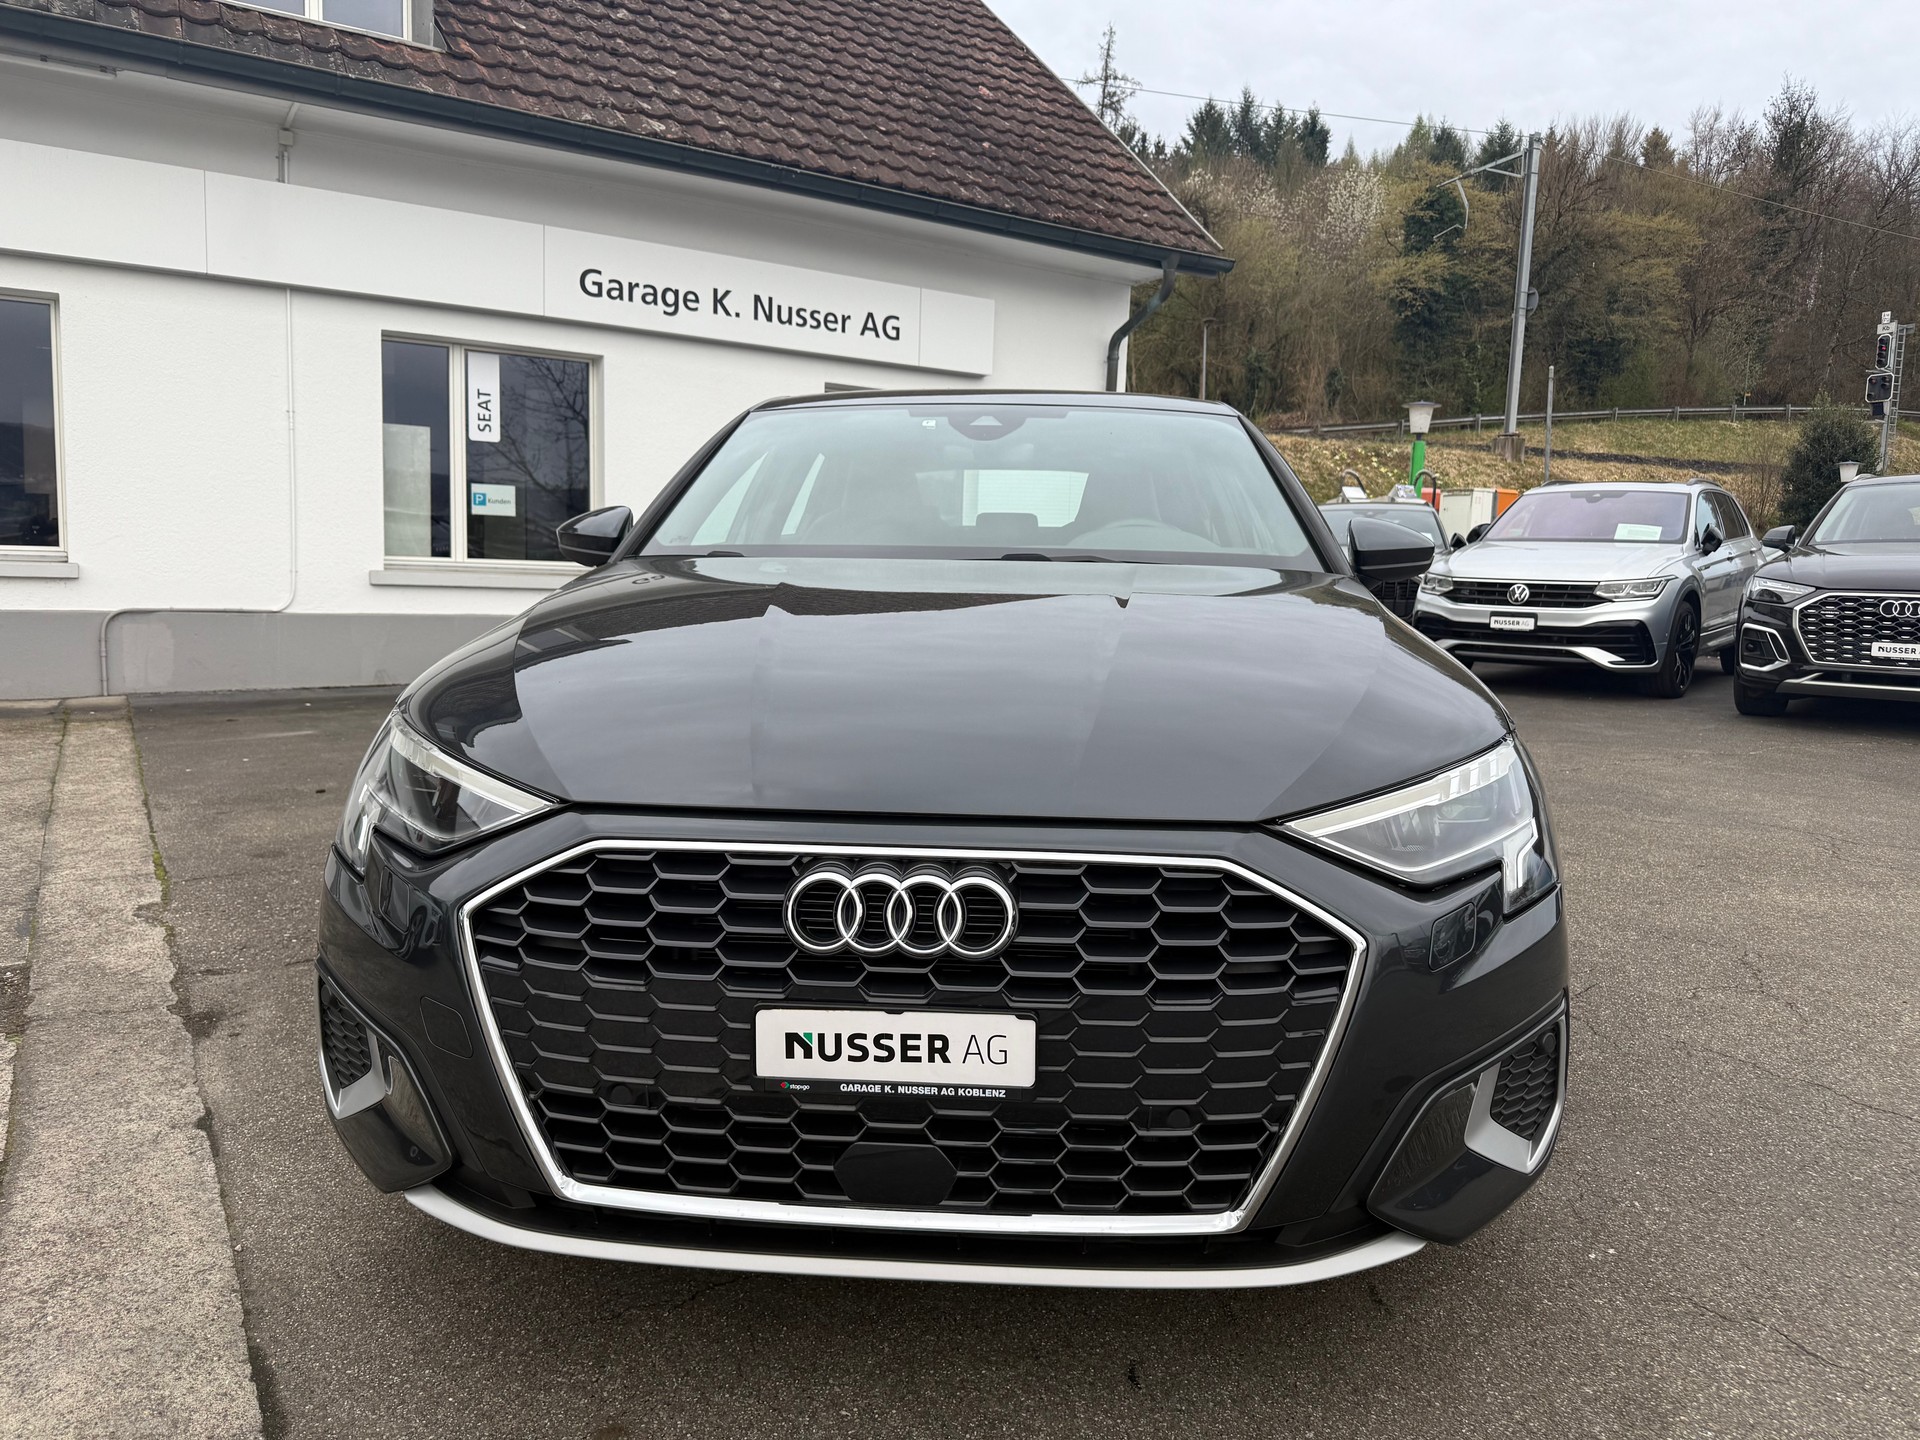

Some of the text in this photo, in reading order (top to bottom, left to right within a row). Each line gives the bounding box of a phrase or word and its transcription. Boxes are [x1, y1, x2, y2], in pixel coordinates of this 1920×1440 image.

[579, 268, 901, 341] Garage K. Nusser AG
[477, 388, 492, 433] SEAT
[488, 496, 511, 505] Kunden
[1878, 646, 1917, 655] NUSSER
[785, 1032, 1008, 1065] NUSSER AG
[840, 1083, 1006, 1098] GARAGE K. NUSSER AG KOBLENZ
